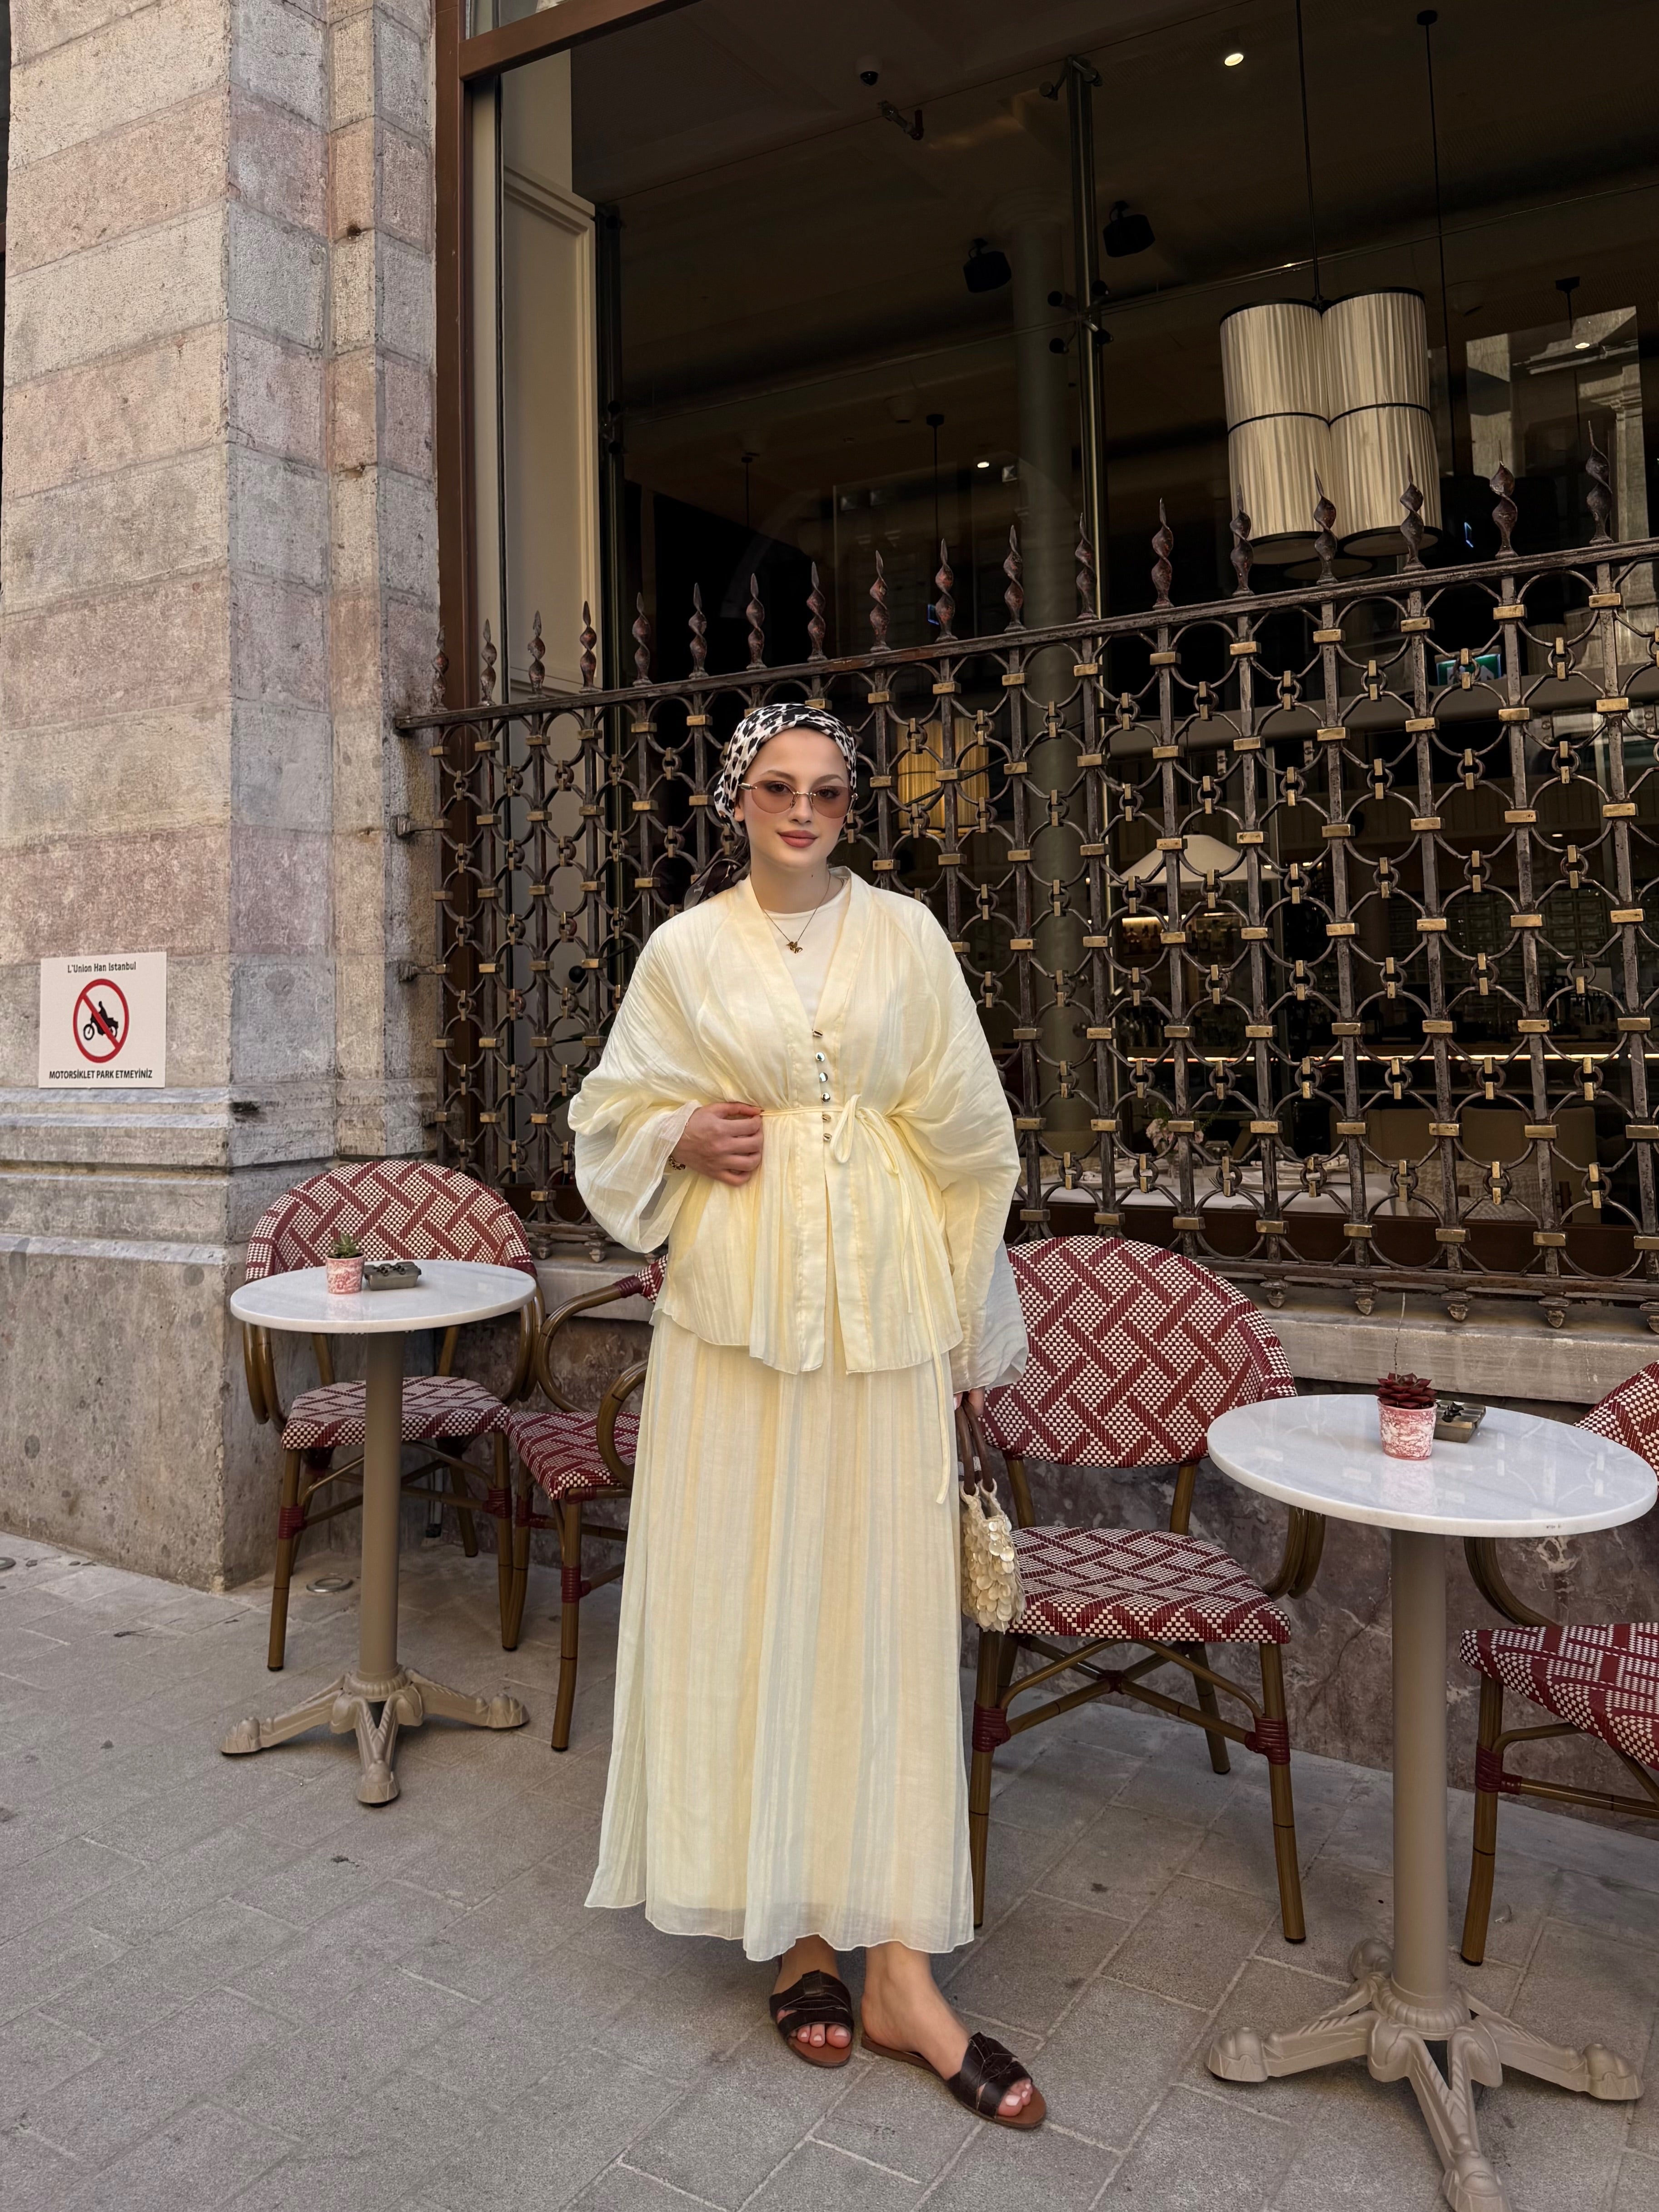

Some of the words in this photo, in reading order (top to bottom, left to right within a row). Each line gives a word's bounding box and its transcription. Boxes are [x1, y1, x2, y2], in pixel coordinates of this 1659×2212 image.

[94, 963, 106, 972] Han
[49, 1069, 95, 1079] MOTORSİKLET
[96, 1070, 114, 1079] PARK
[115, 1068, 153, 1079] ETMEYİNİZ
